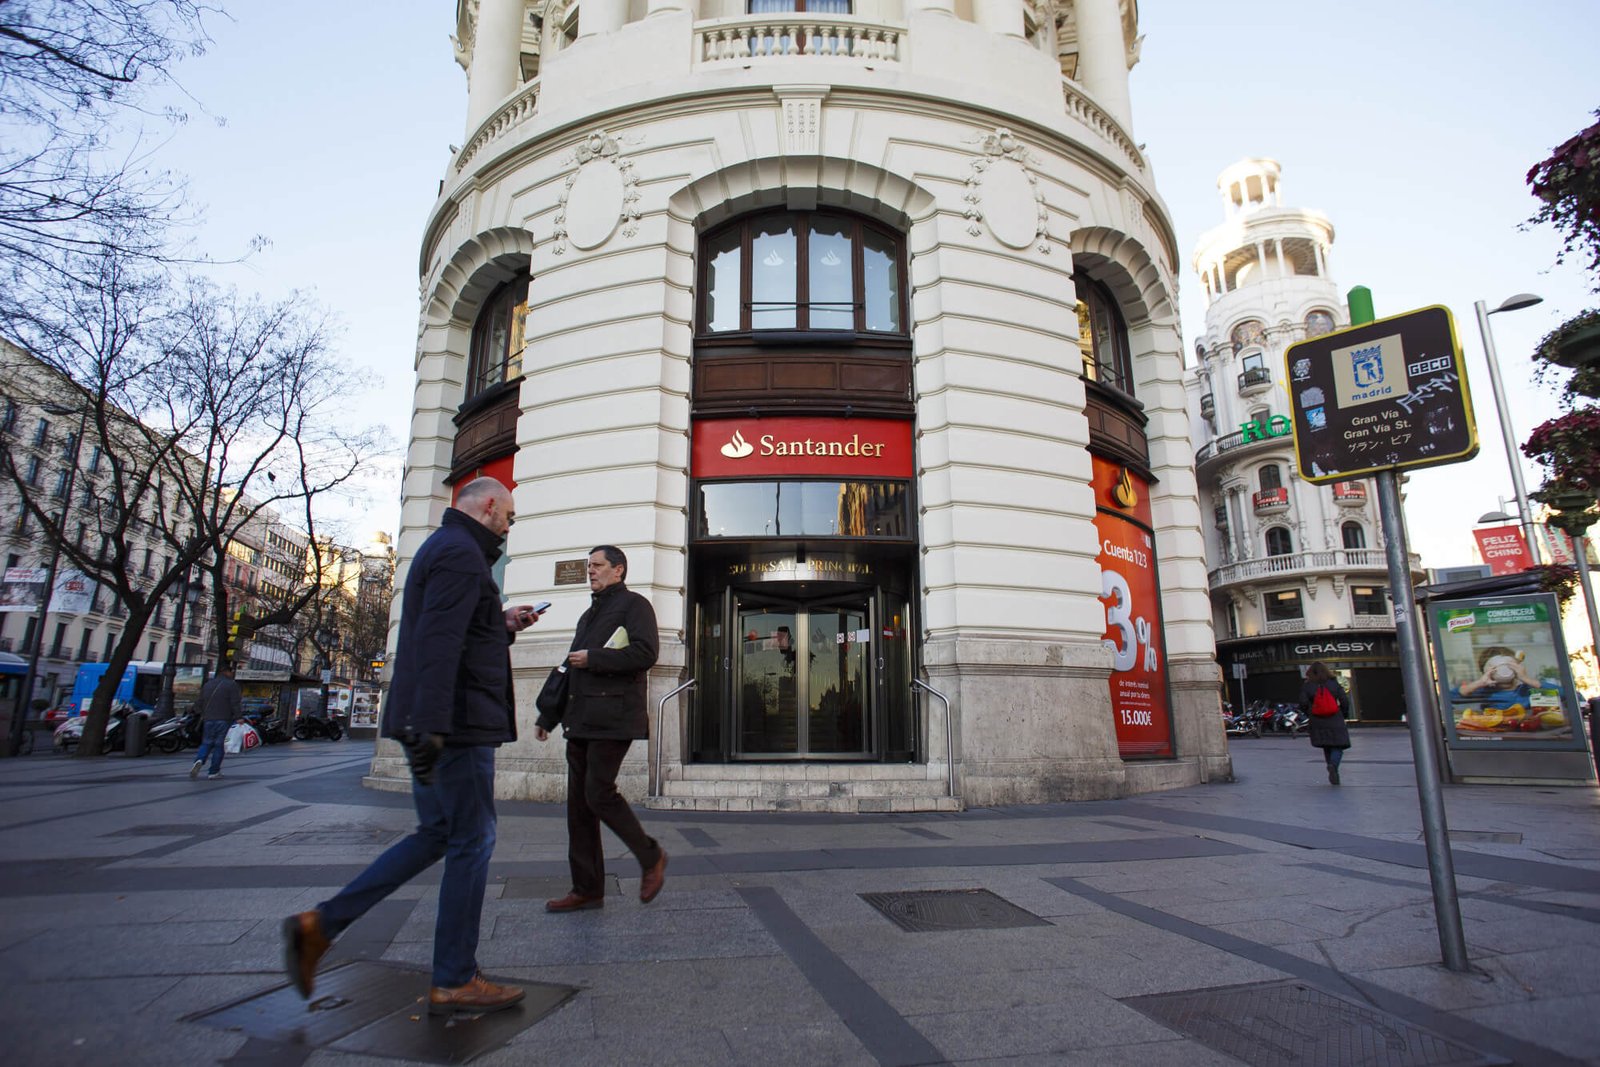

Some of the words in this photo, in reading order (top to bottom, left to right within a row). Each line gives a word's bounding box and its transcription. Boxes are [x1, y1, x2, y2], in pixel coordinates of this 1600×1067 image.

[1352, 386, 1392, 400] madrid
[1352, 415, 1377, 426] Gran
[1344, 429, 1369, 439] Gran
[1395, 420, 1412, 429] St.
[760, 434, 884, 457] Santander
[1482, 535, 1518, 546] FELIZ
[1104, 539, 1134, 562] Cuenta
[1134, 549, 1147, 568] 123
[1486, 548, 1522, 558] CHINO
[1294, 642, 1374, 654] GRASSY
[1121, 709, 1152, 726] 15.000€
